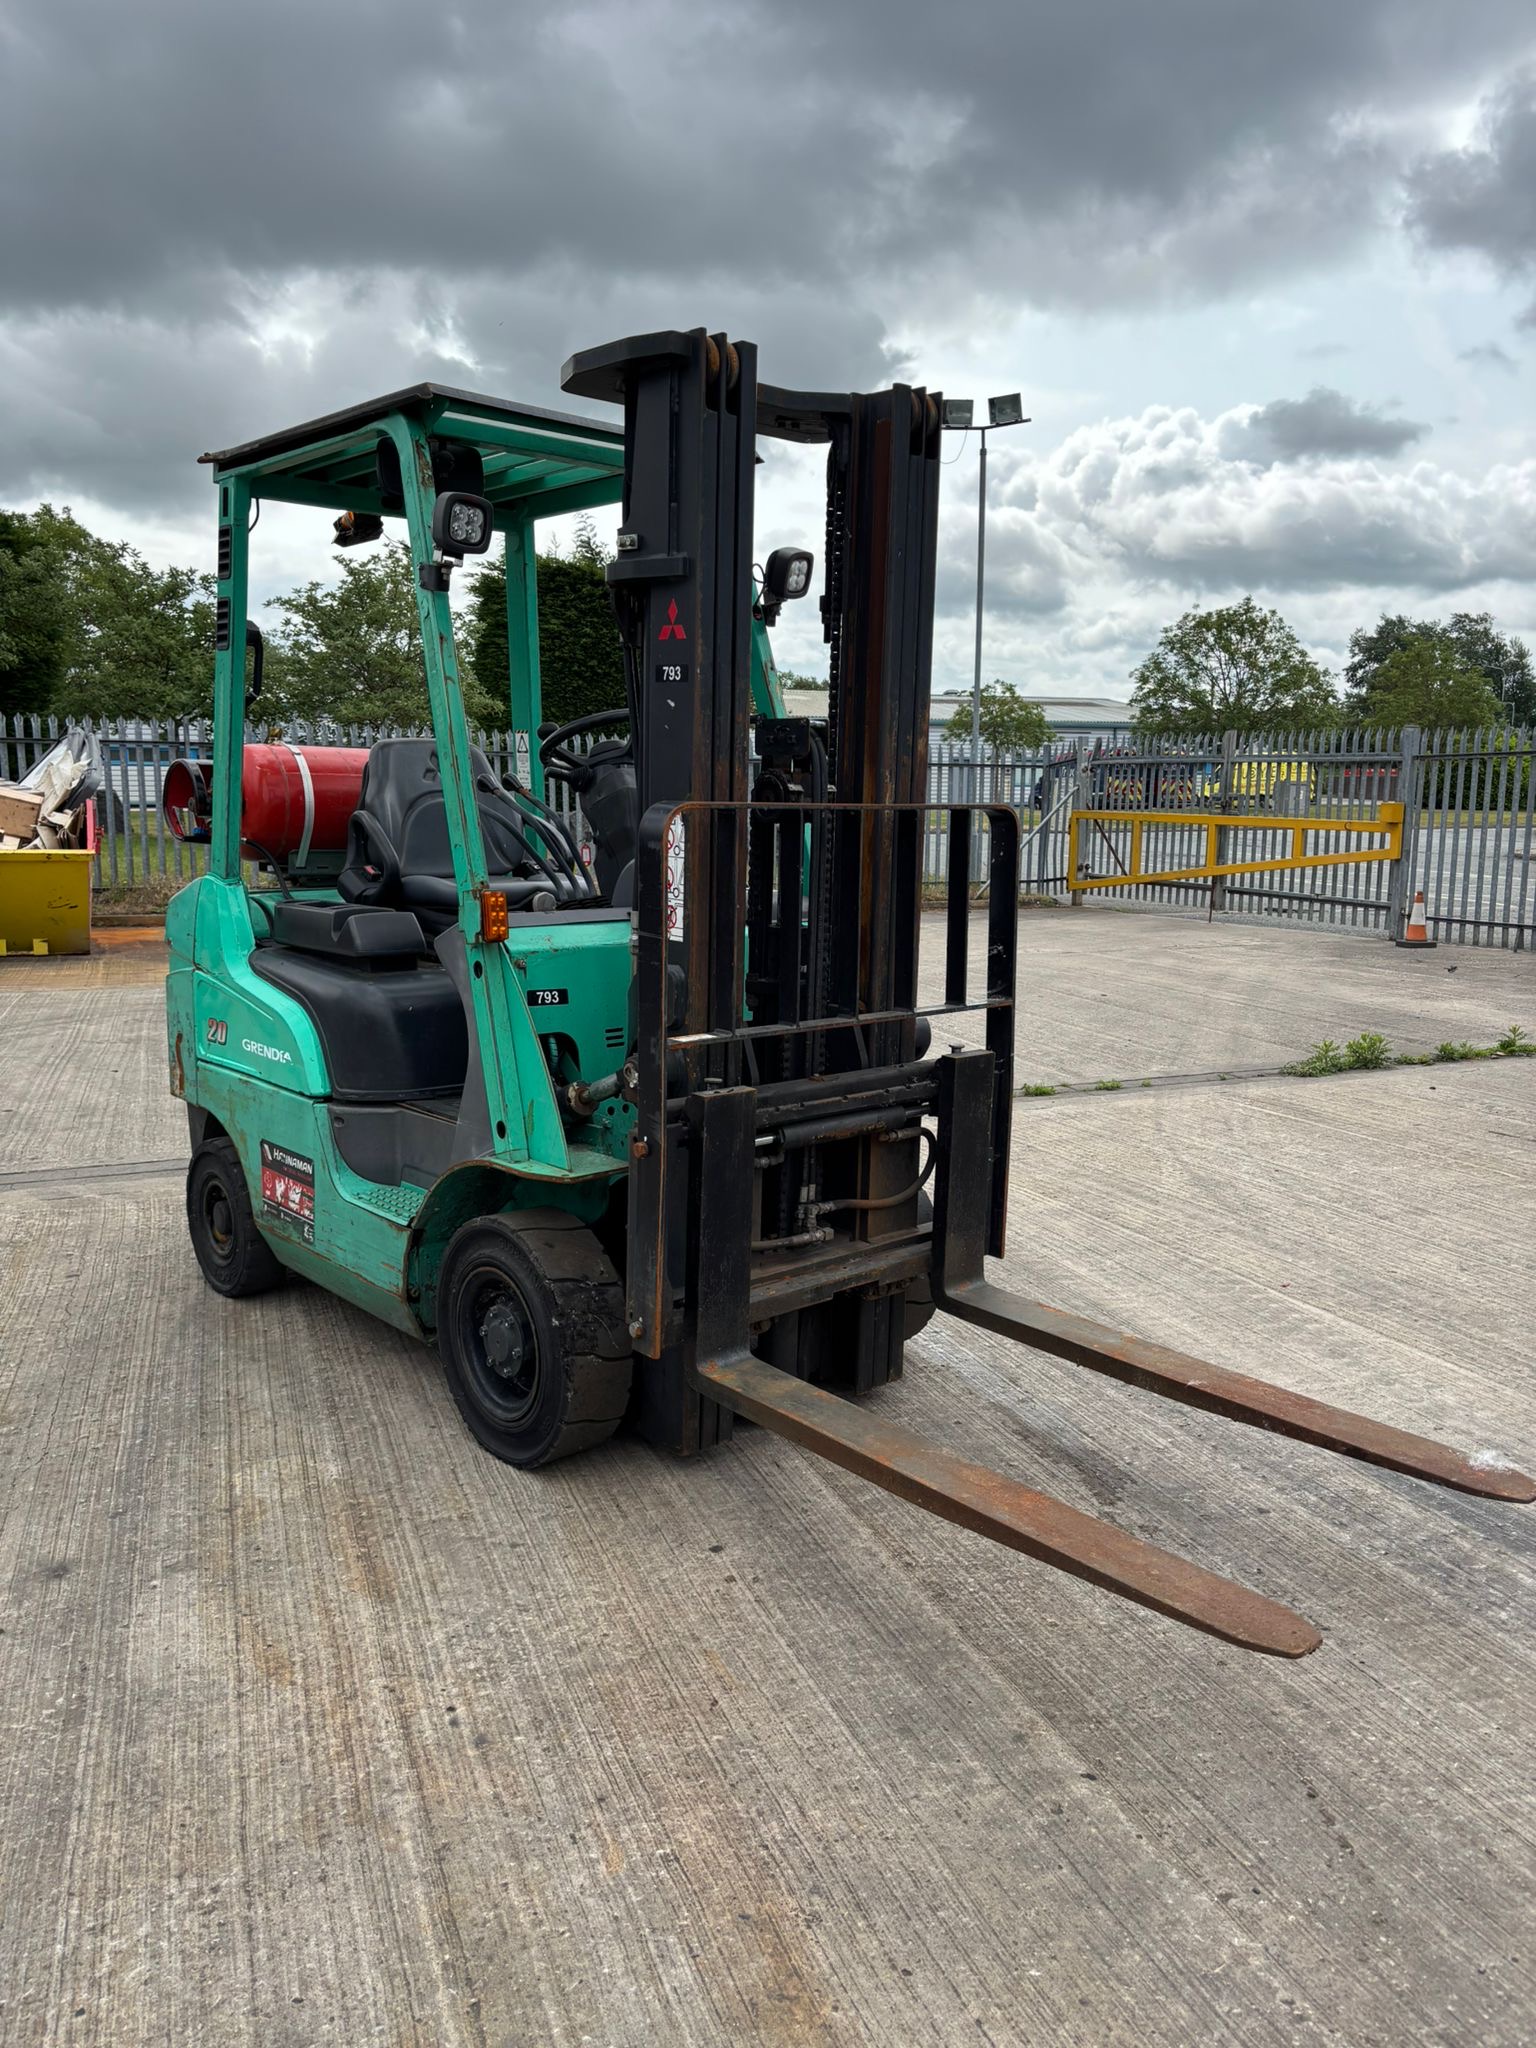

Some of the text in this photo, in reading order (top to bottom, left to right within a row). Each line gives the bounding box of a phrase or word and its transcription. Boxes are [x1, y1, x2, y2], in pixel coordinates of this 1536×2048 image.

[662, 665, 681, 681] 793
[535, 990, 560, 1005] 793
[207, 1018, 228, 1046] 20
